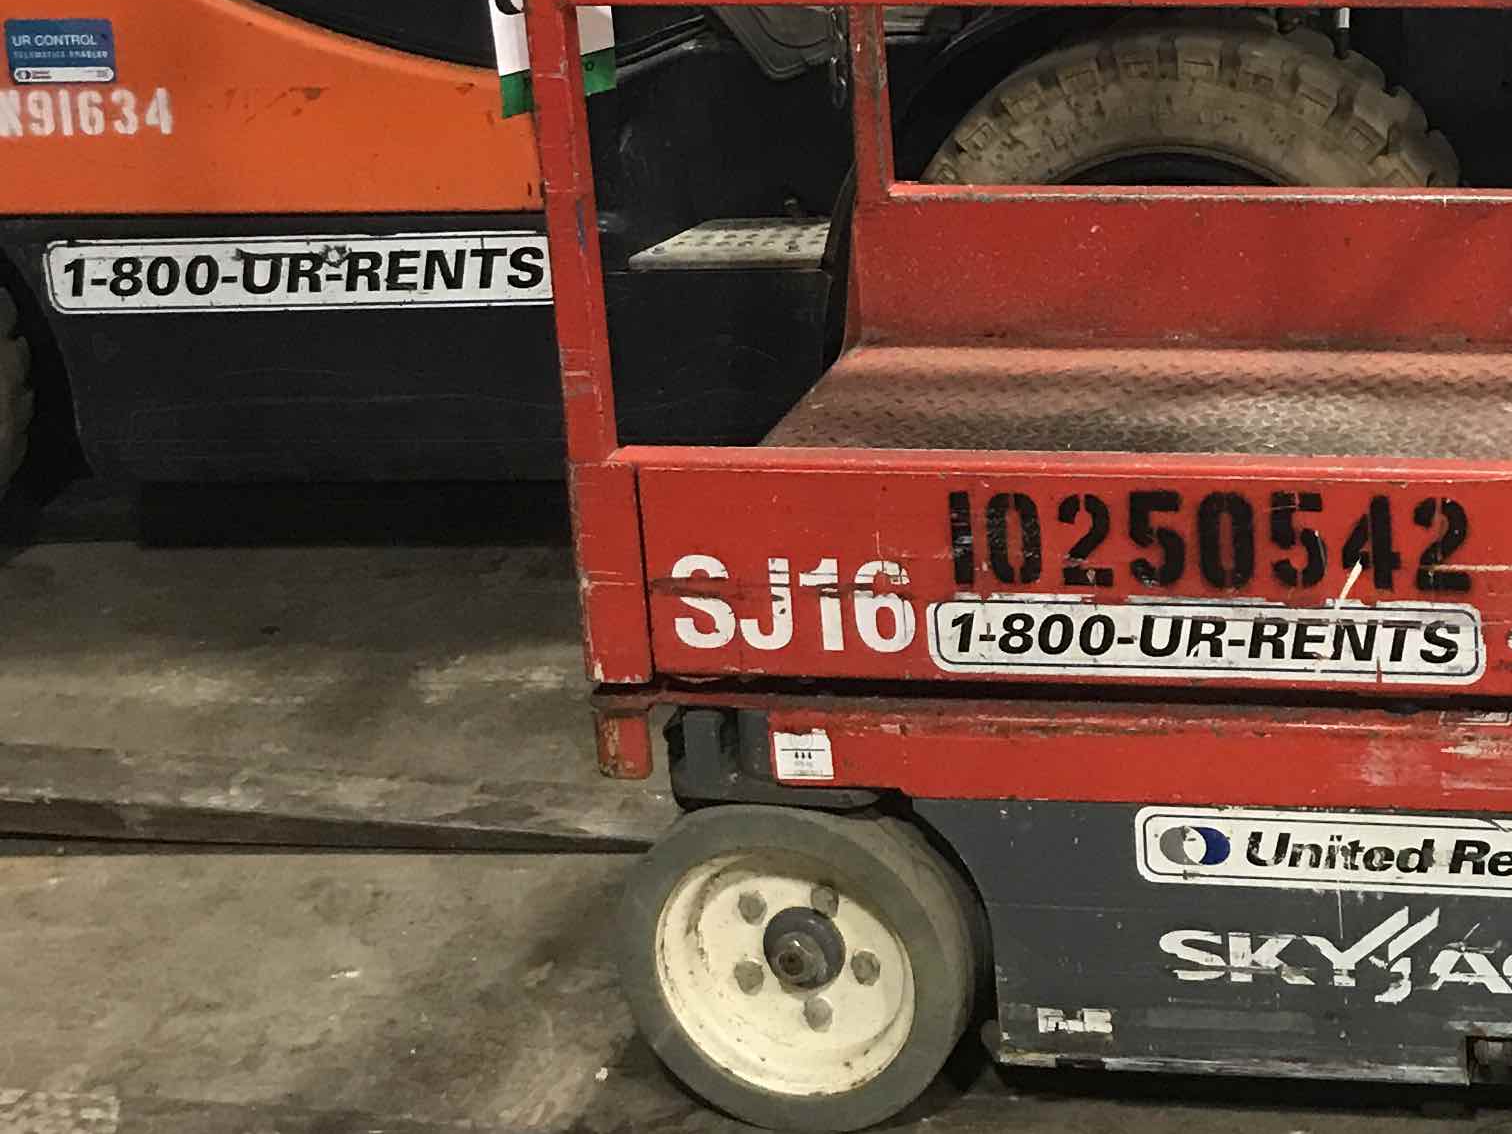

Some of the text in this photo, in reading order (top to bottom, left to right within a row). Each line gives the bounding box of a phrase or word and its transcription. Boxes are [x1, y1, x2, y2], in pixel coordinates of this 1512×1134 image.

[12, 34, 97, 47] UR CONTROL
[63, 246, 545, 297] 1-800-UR-RENTS
[946, 490, 1471, 593] 10250542
[670, 554, 917, 653] SJ16
[949, 611, 1462, 663] 1-800-UR-RENTS
[1246, 830, 1434, 874] United
